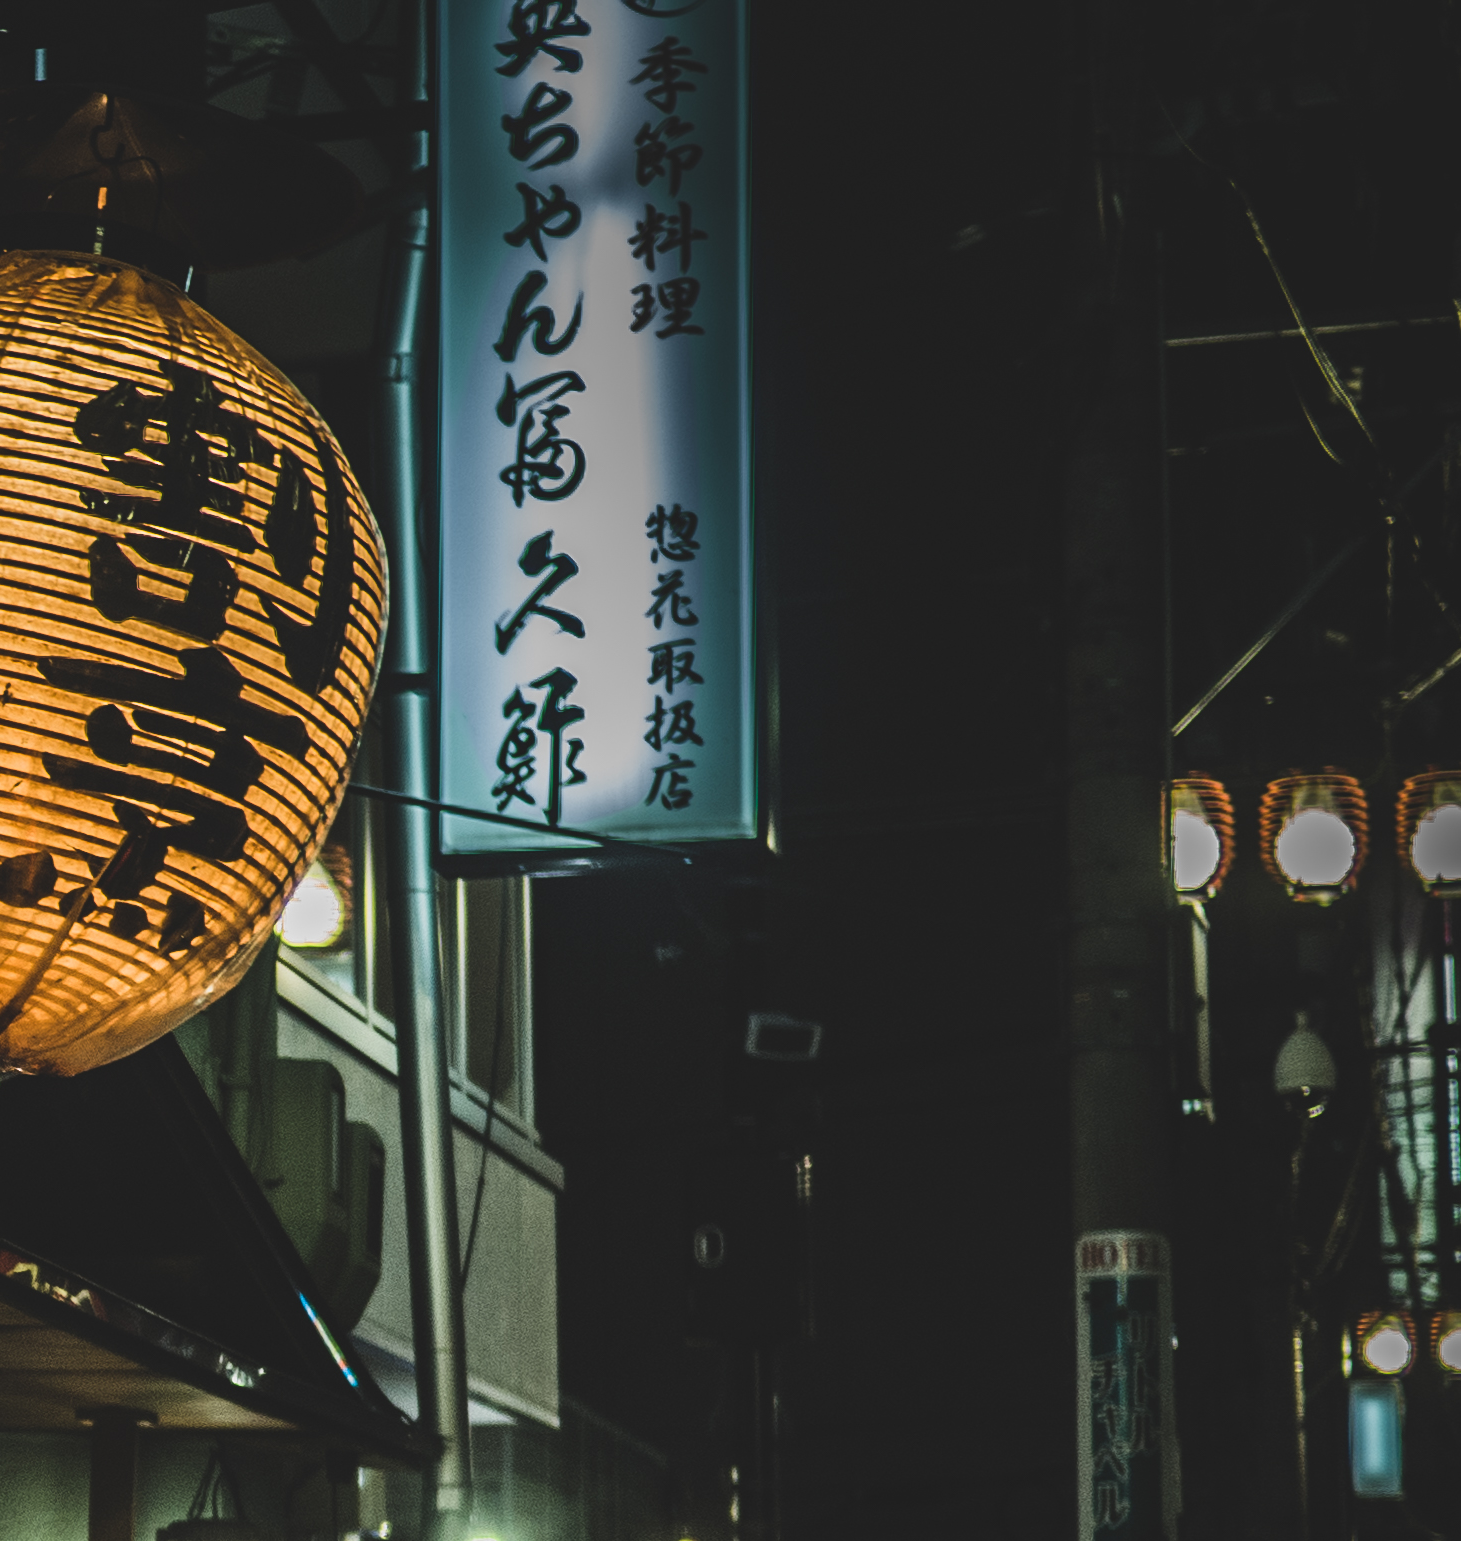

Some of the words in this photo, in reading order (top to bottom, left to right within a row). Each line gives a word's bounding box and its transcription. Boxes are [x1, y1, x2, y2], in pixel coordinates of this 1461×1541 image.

[627, 36, 710, 340] 季節料理
[643, 503, 706, 811] 惣花取扱店
